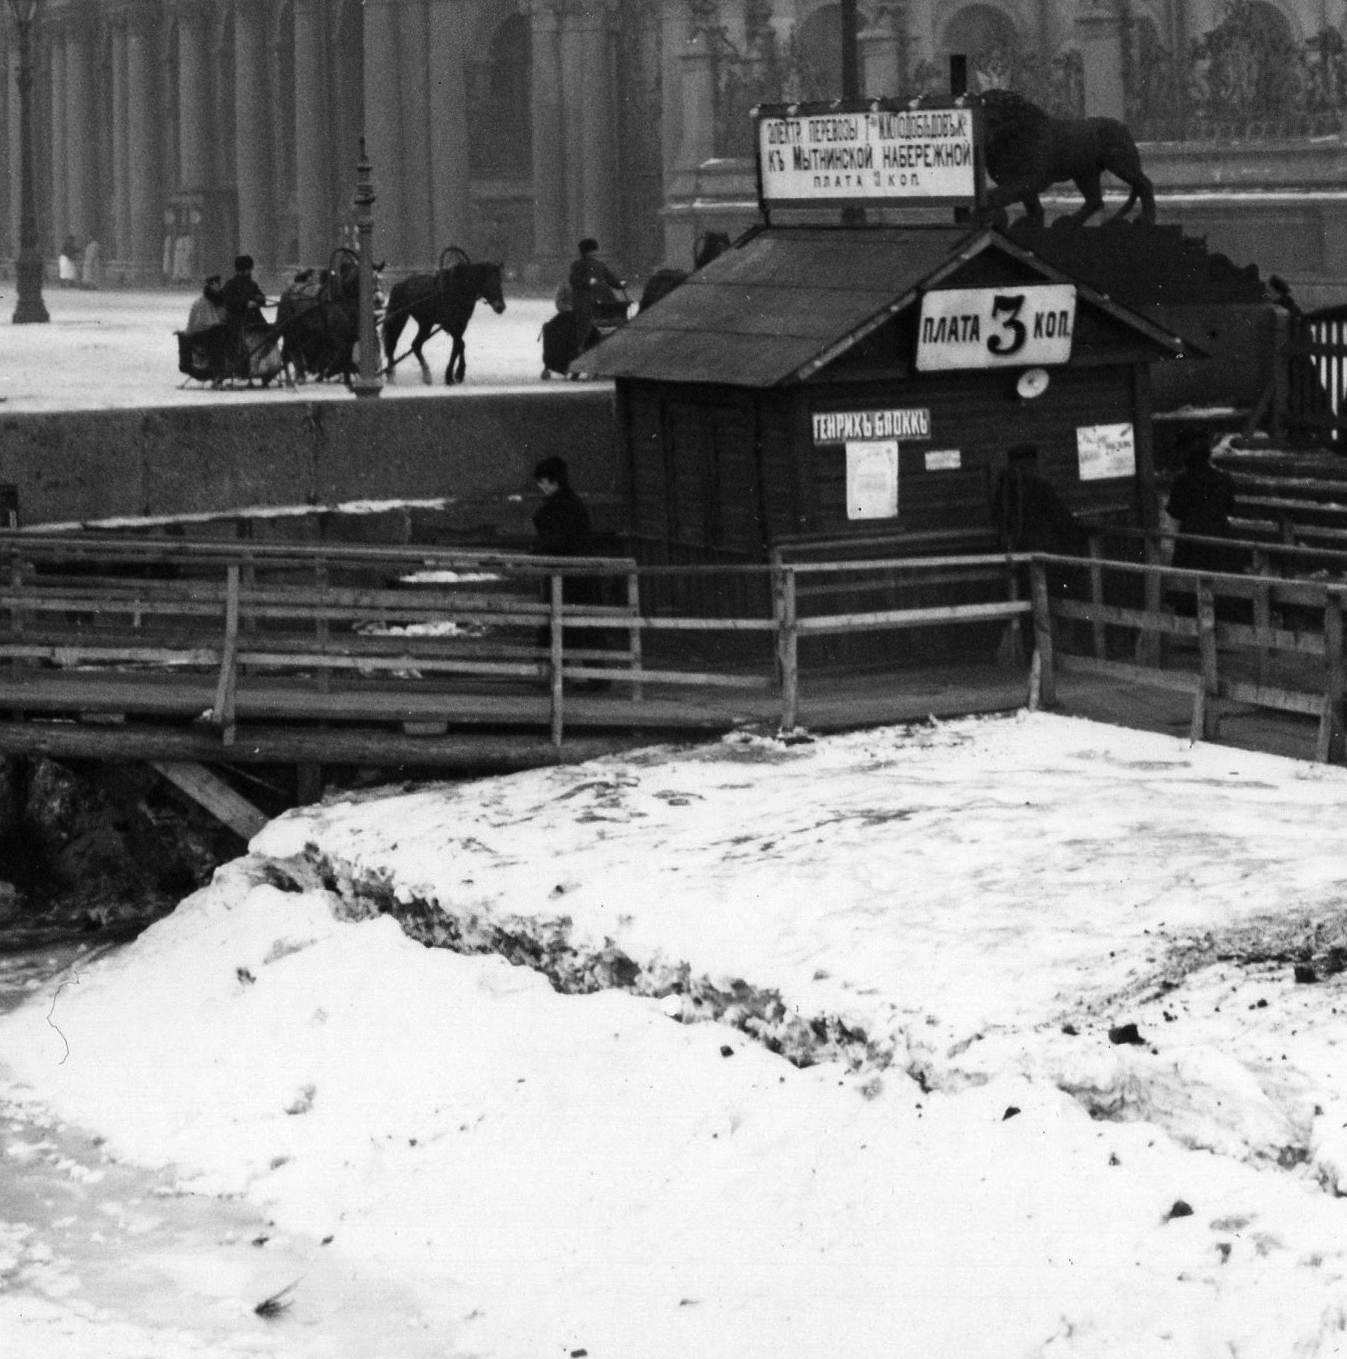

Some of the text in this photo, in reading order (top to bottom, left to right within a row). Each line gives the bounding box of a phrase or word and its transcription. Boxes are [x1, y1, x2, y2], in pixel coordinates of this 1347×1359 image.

[809, 117, 858, 143] ПЕРЕВОЗЫ
[769, 149, 785, 172] КЪ
[882, 139, 973, 169] НАБЕРЕЖНОЙ
[813, 174, 863, 188] ПЛАТА
[921, 294, 1071, 356] ПЛАТА 3 КОП.
[813, 409, 928, 440] ГЕНРИХЪ БЛОККЪ
